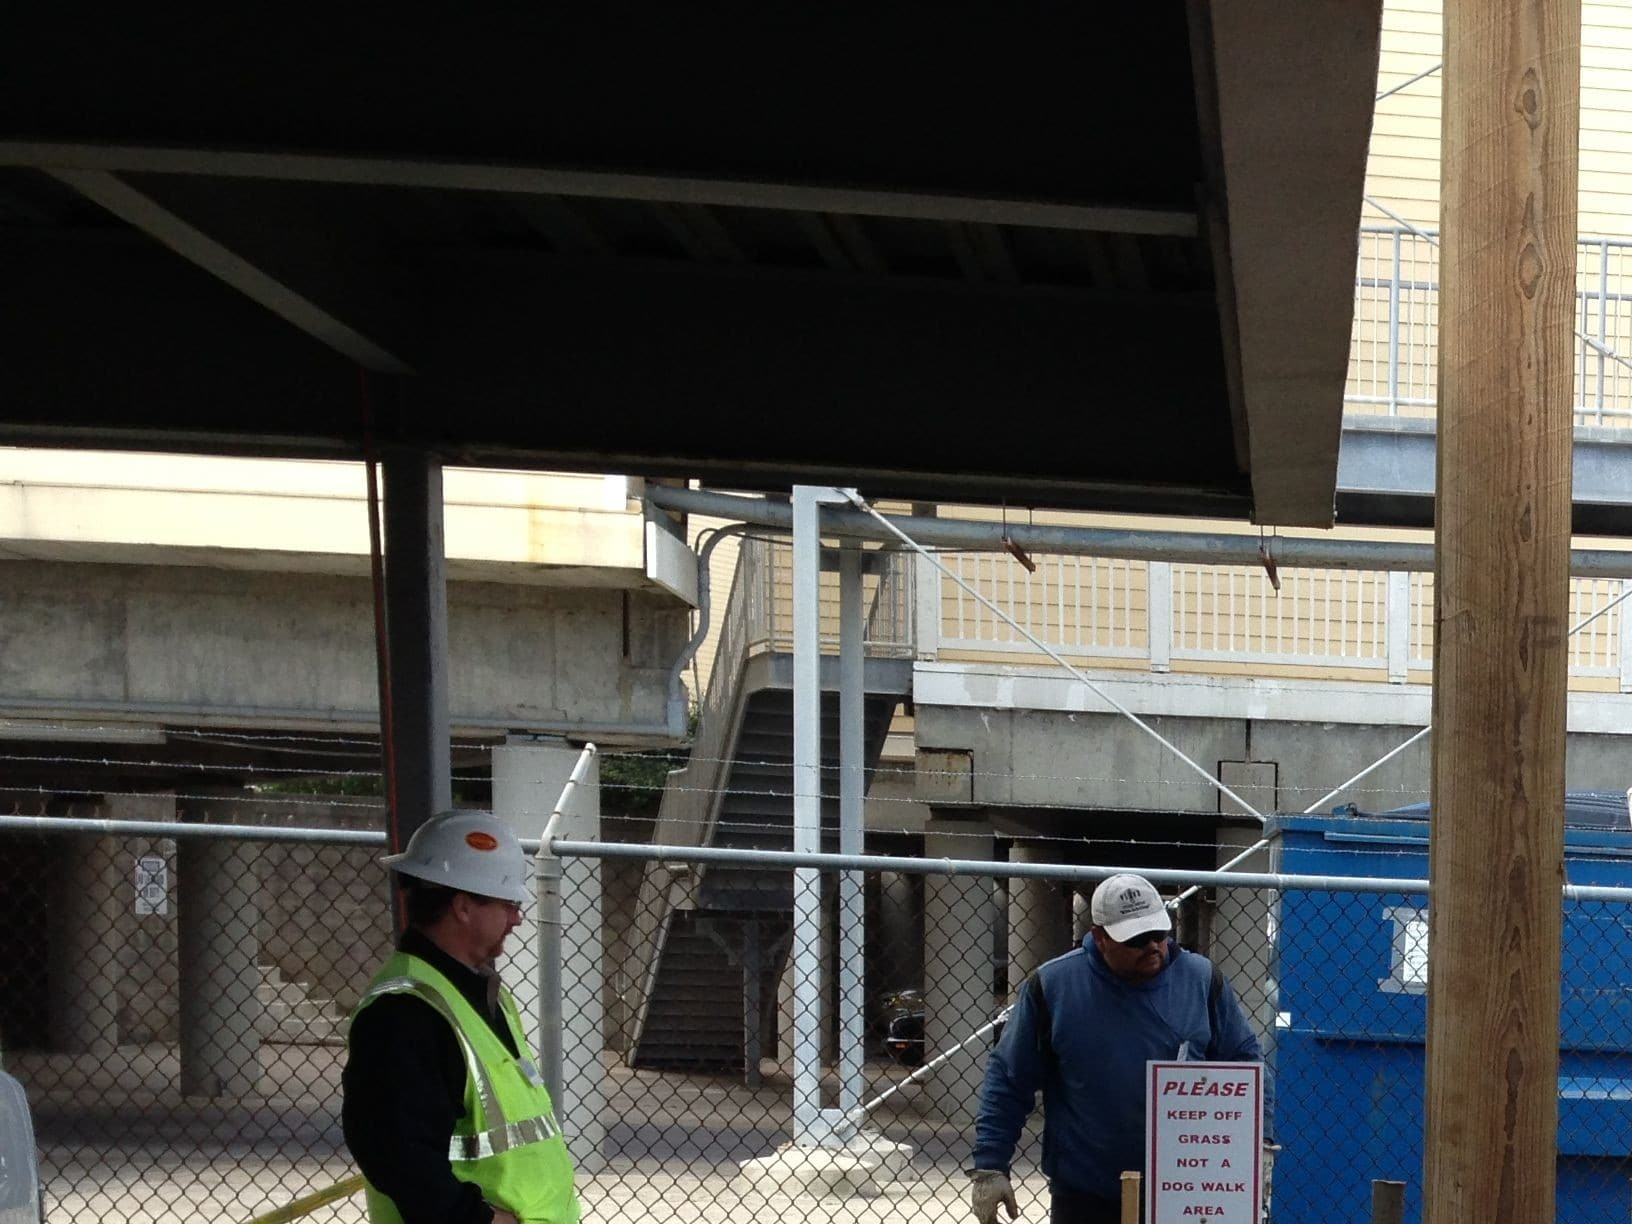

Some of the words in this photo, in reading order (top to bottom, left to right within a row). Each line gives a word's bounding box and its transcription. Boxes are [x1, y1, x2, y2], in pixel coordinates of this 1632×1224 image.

[1163, 1081, 1249, 1096] PLEASE
[1167, 1110, 1207, 1120] KEEP
[1214, 1111, 1242, 1120] OFF
[1178, 1135, 1231, 1144] GRASS
[1177, 1158, 1208, 1167] NOT
[1221, 1159, 1230, 1168] A
[1162, 1182, 1194, 1191] DOG
[1201, 1182, 1244, 1192] WALK
[1183, 1206, 1224, 1216] AREA
